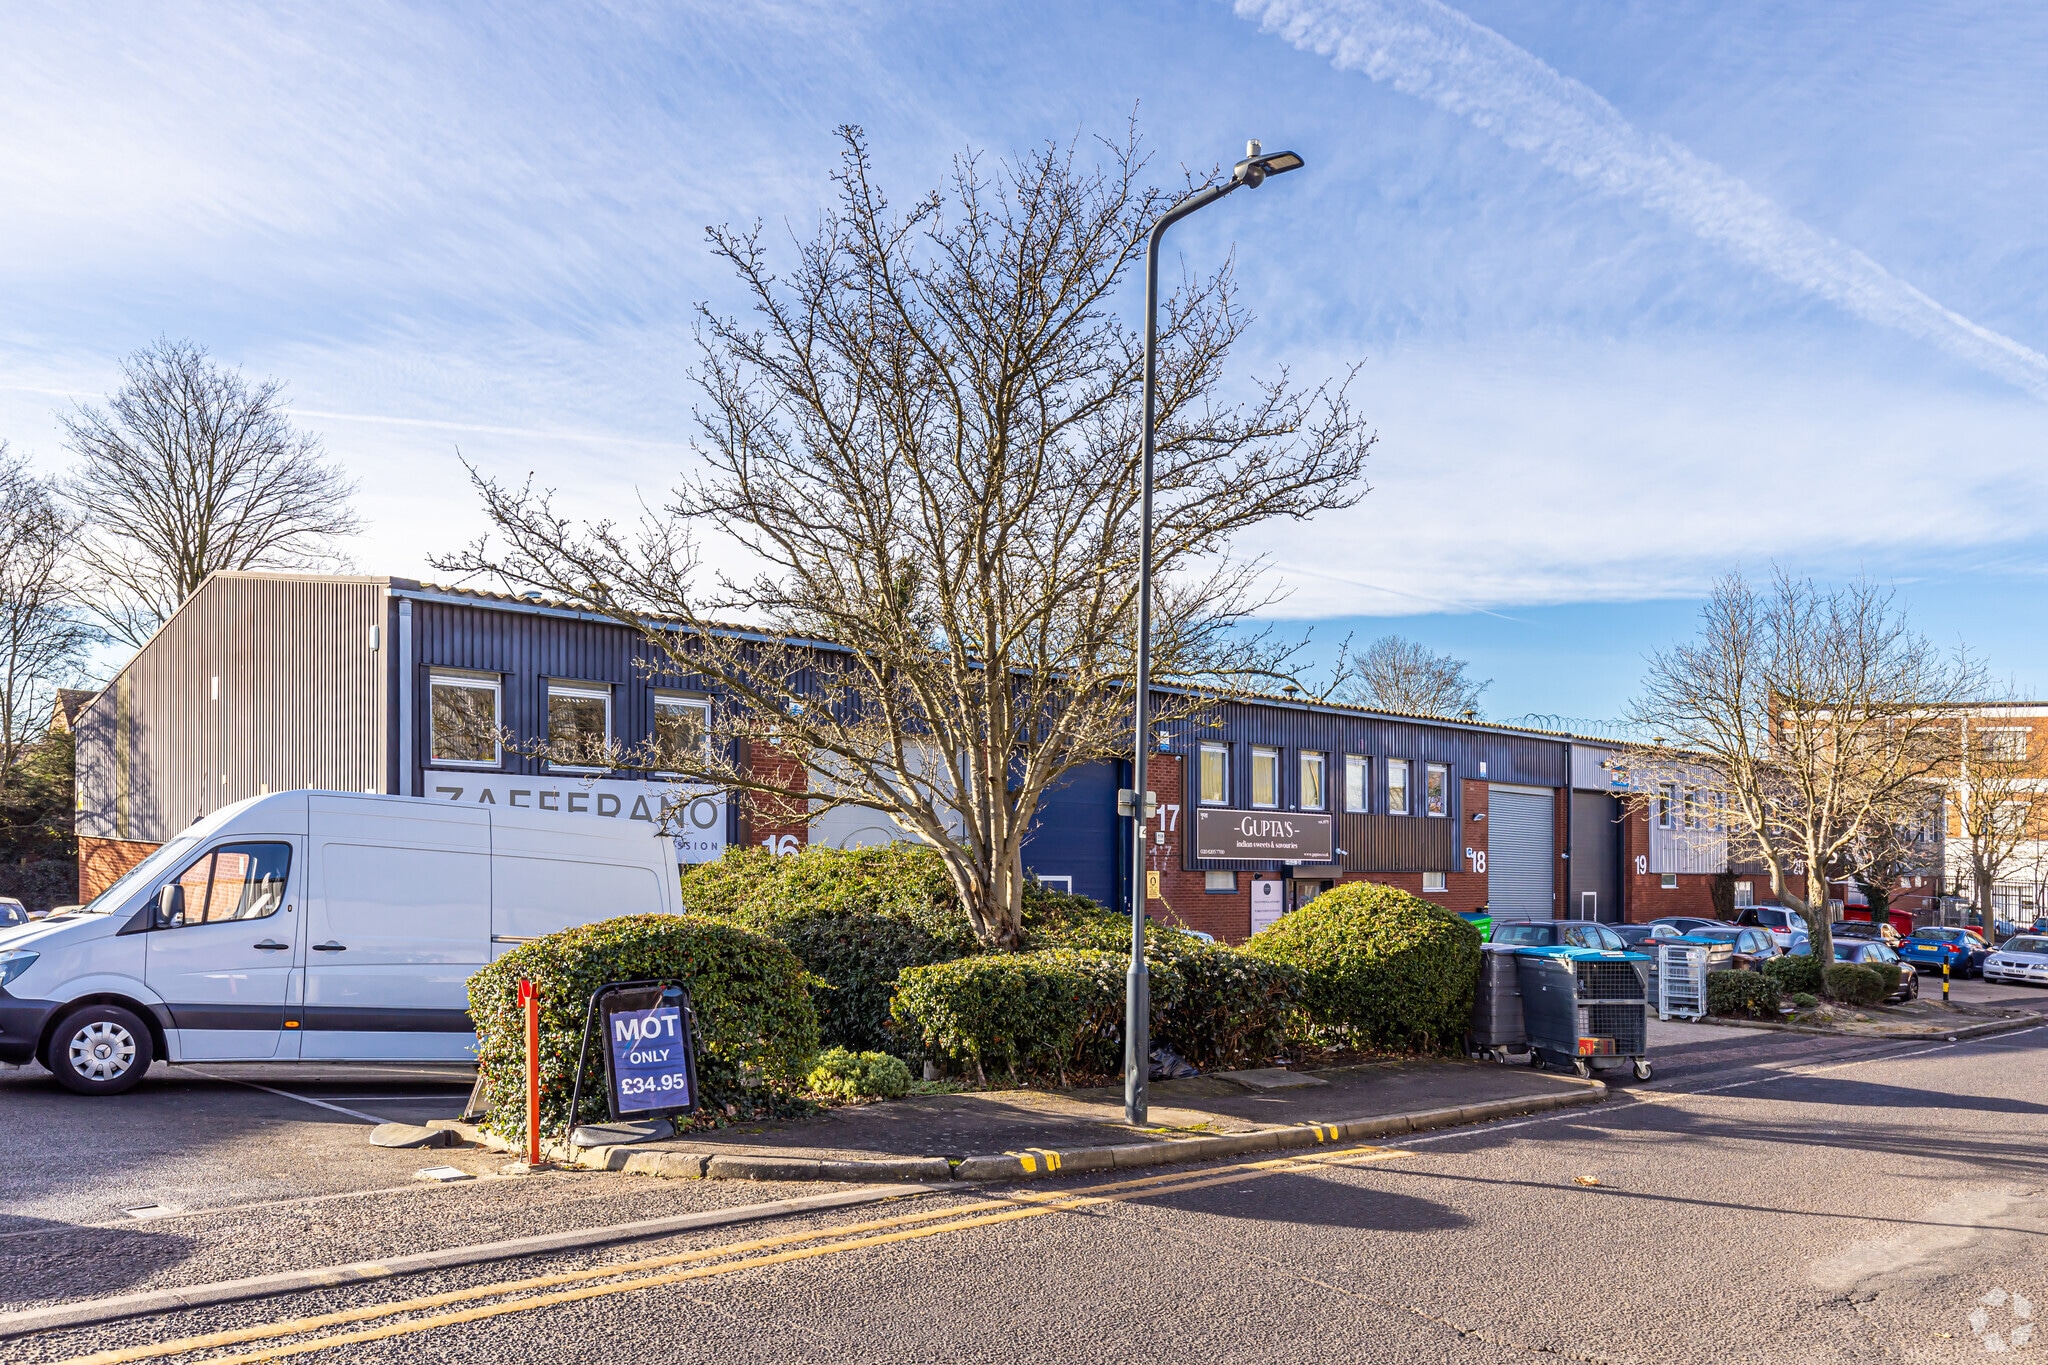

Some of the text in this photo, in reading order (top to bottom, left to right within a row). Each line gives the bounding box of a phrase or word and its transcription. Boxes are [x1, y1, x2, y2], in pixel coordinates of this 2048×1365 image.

[1156, 804, 1180, 831] 17
[762, 834, 799, 857] 16
[1236, 840, 1252, 848] indian
[1471, 851, 1486, 873] 18
[1634, 855, 1647, 874] 19
[615, 1015, 678, 1042] MOT
[630, 1049, 670, 1064] ONLY
[621, 1074, 684, 1095] £34.95
